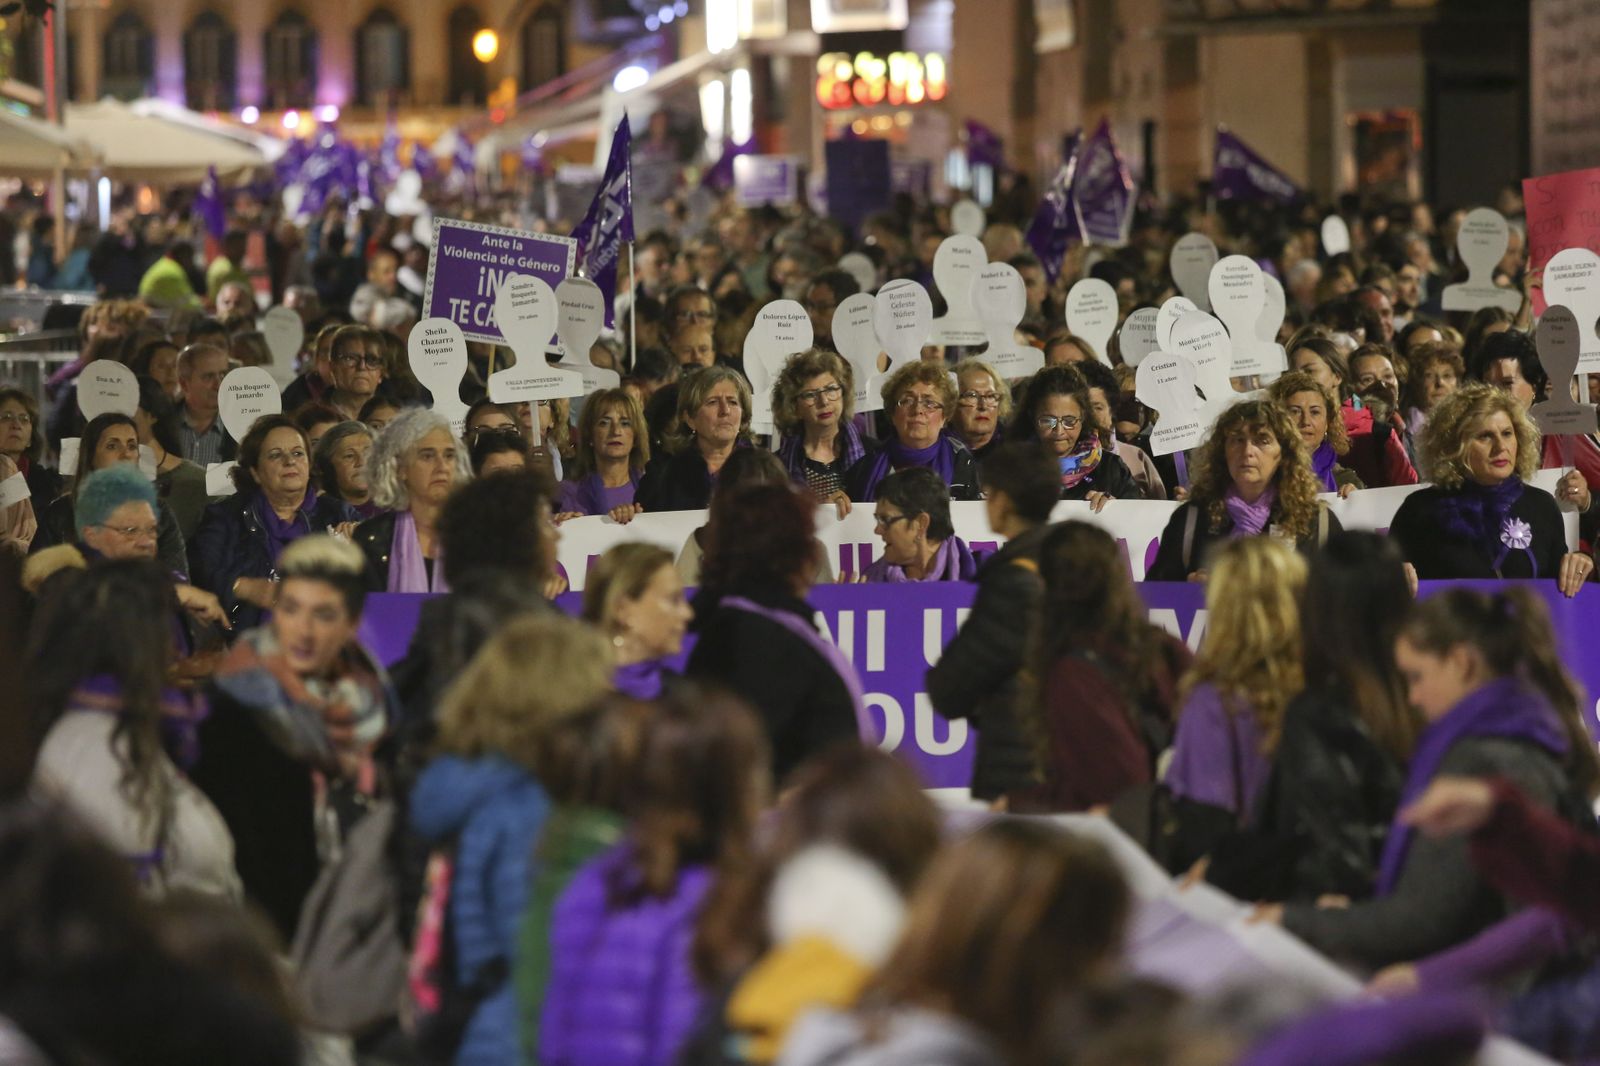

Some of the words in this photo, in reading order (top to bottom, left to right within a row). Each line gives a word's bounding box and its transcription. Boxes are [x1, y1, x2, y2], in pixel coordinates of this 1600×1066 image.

[482, 235, 509, 250] Ante
[512, 239, 523, 251] la
[443, 245, 498, 264] Violencia
[500, 254, 515, 266] de
[517, 256, 561, 273] Género
[889, 292, 916, 301] Romina
[891, 301, 916, 309] Celeste
[449, 298, 471, 324] TE
[893, 310, 915, 318] Núñez
[763, 313, 787, 321] Dolores
[788, 313, 807, 321] López
[425, 327, 447, 336] Sheila
[421, 337, 454, 346] Chazarra
[1178, 336, 1200, 347] Mónica
[424, 346, 454, 356] Moyano
[1150, 361, 1177, 372] Cristian
[236, 392, 264, 400] Jamardo
